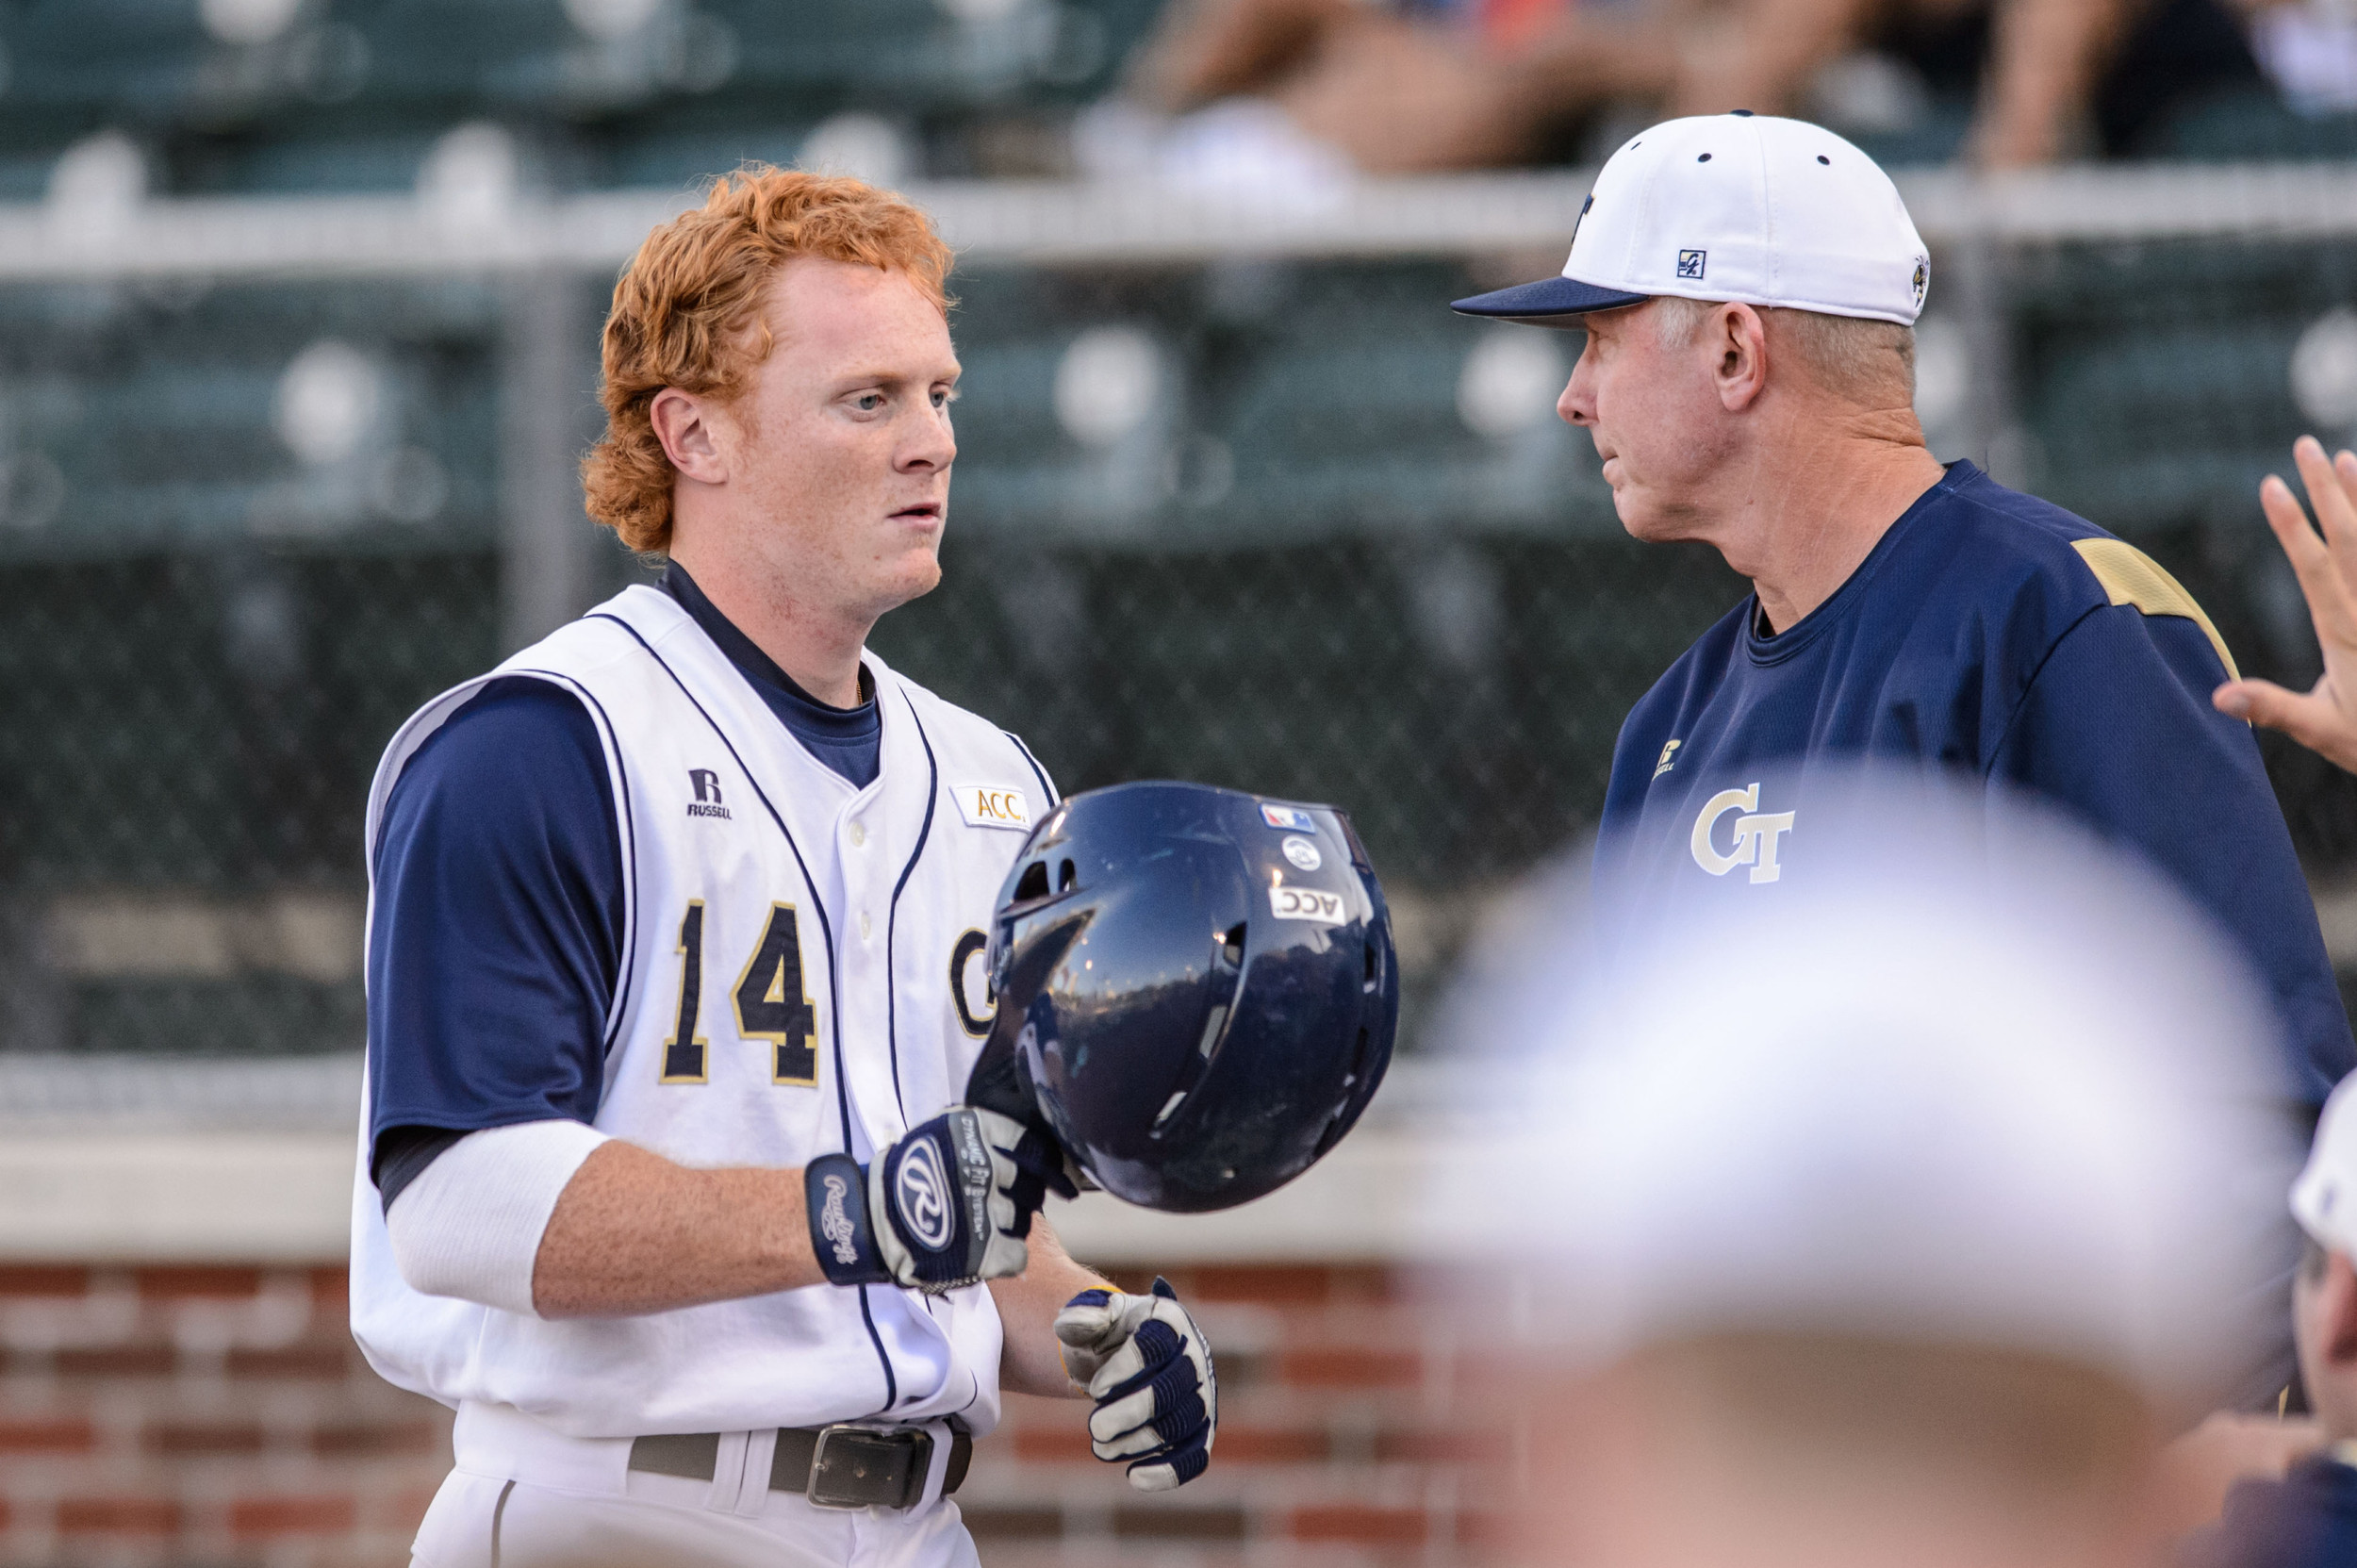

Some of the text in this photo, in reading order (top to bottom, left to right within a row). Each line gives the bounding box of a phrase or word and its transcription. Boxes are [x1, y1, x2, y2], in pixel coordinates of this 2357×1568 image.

[687, 768, 721, 804] R
[687, 803, 733, 820] RUSSELL
[978, 789, 1021, 820] ACC
[1690, 782, 1796, 884] GT
[1281, 891, 1339, 916] ACC
[659, 899, 818, 1089] 14
[822, 1174, 859, 1265] Rawlings
